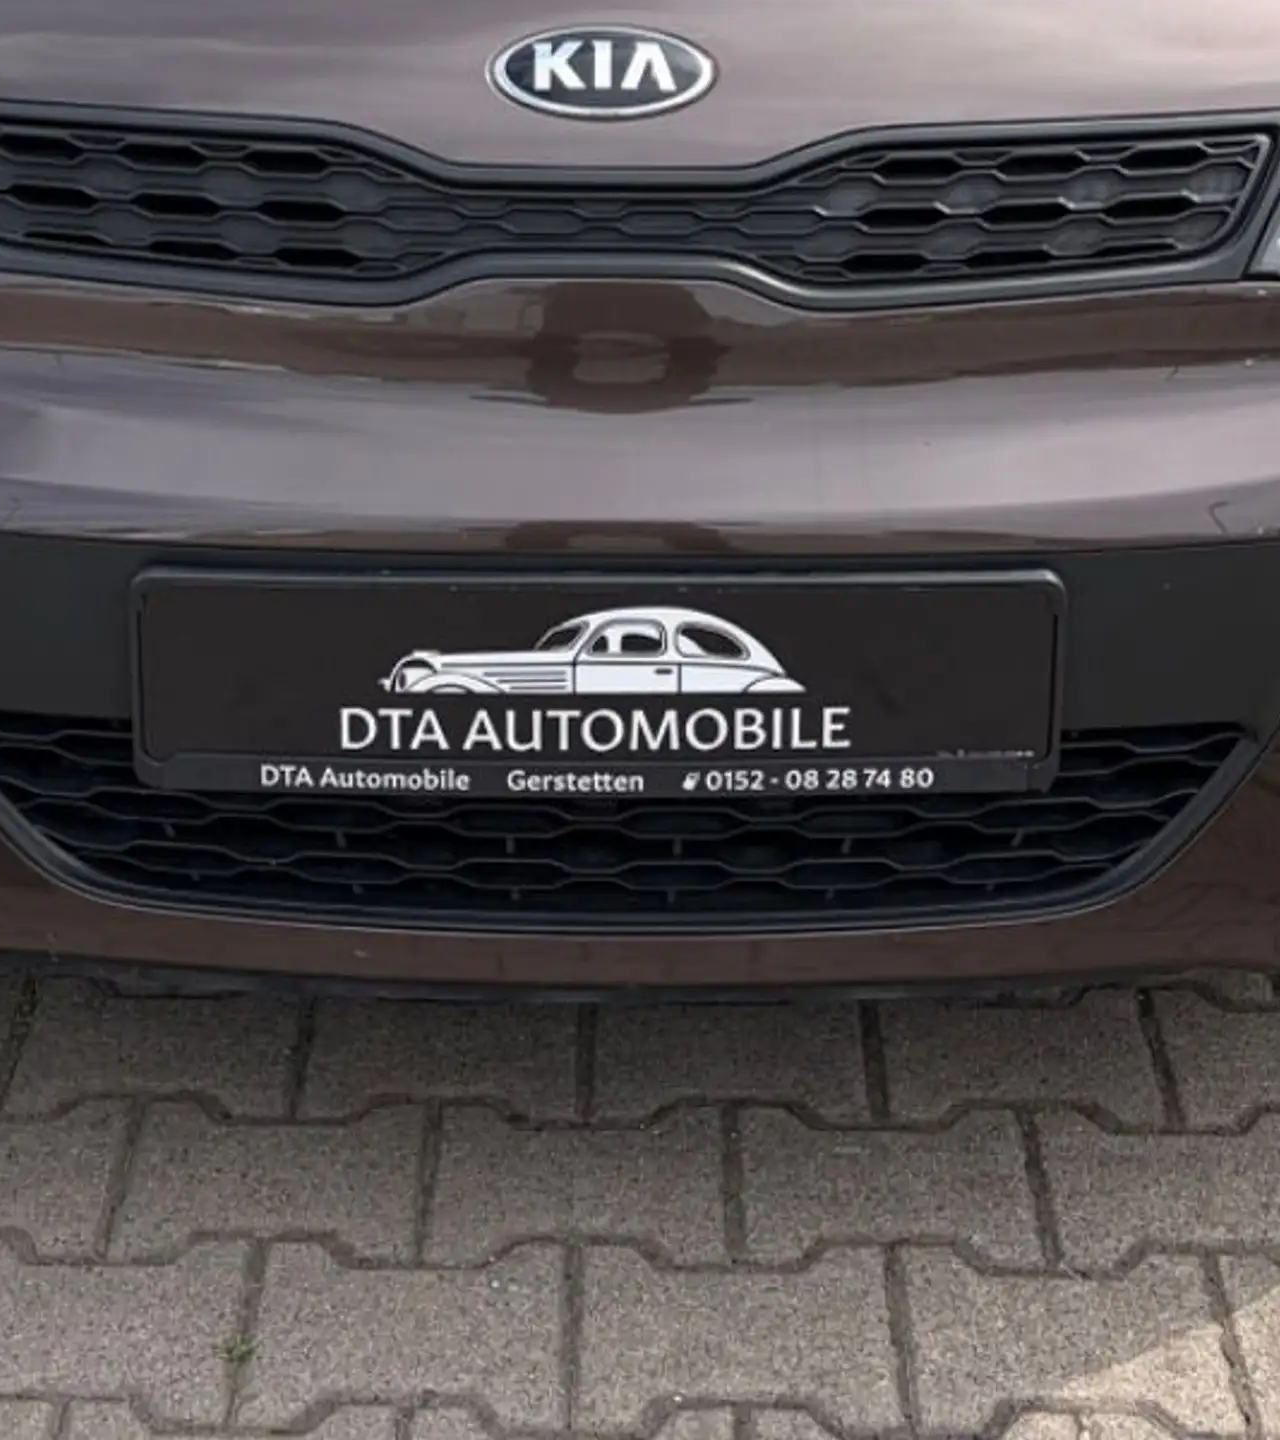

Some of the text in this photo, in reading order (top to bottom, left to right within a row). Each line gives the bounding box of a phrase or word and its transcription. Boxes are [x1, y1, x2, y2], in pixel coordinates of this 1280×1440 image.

[532, 39, 677, 91] KIA
[338, 706, 852, 752] DTA AUTOMOBILE
[260, 763, 315, 788] DTA
[319, 765, 471, 791] Automobile
[506, 768, 645, 793] Gerstetten
[704, 769, 765, 791] 0152
[784, 768, 820, 791] 08
[825, 767, 858, 790] 28
[862, 767, 892, 789] 74
[898, 766, 935, 789] 80
